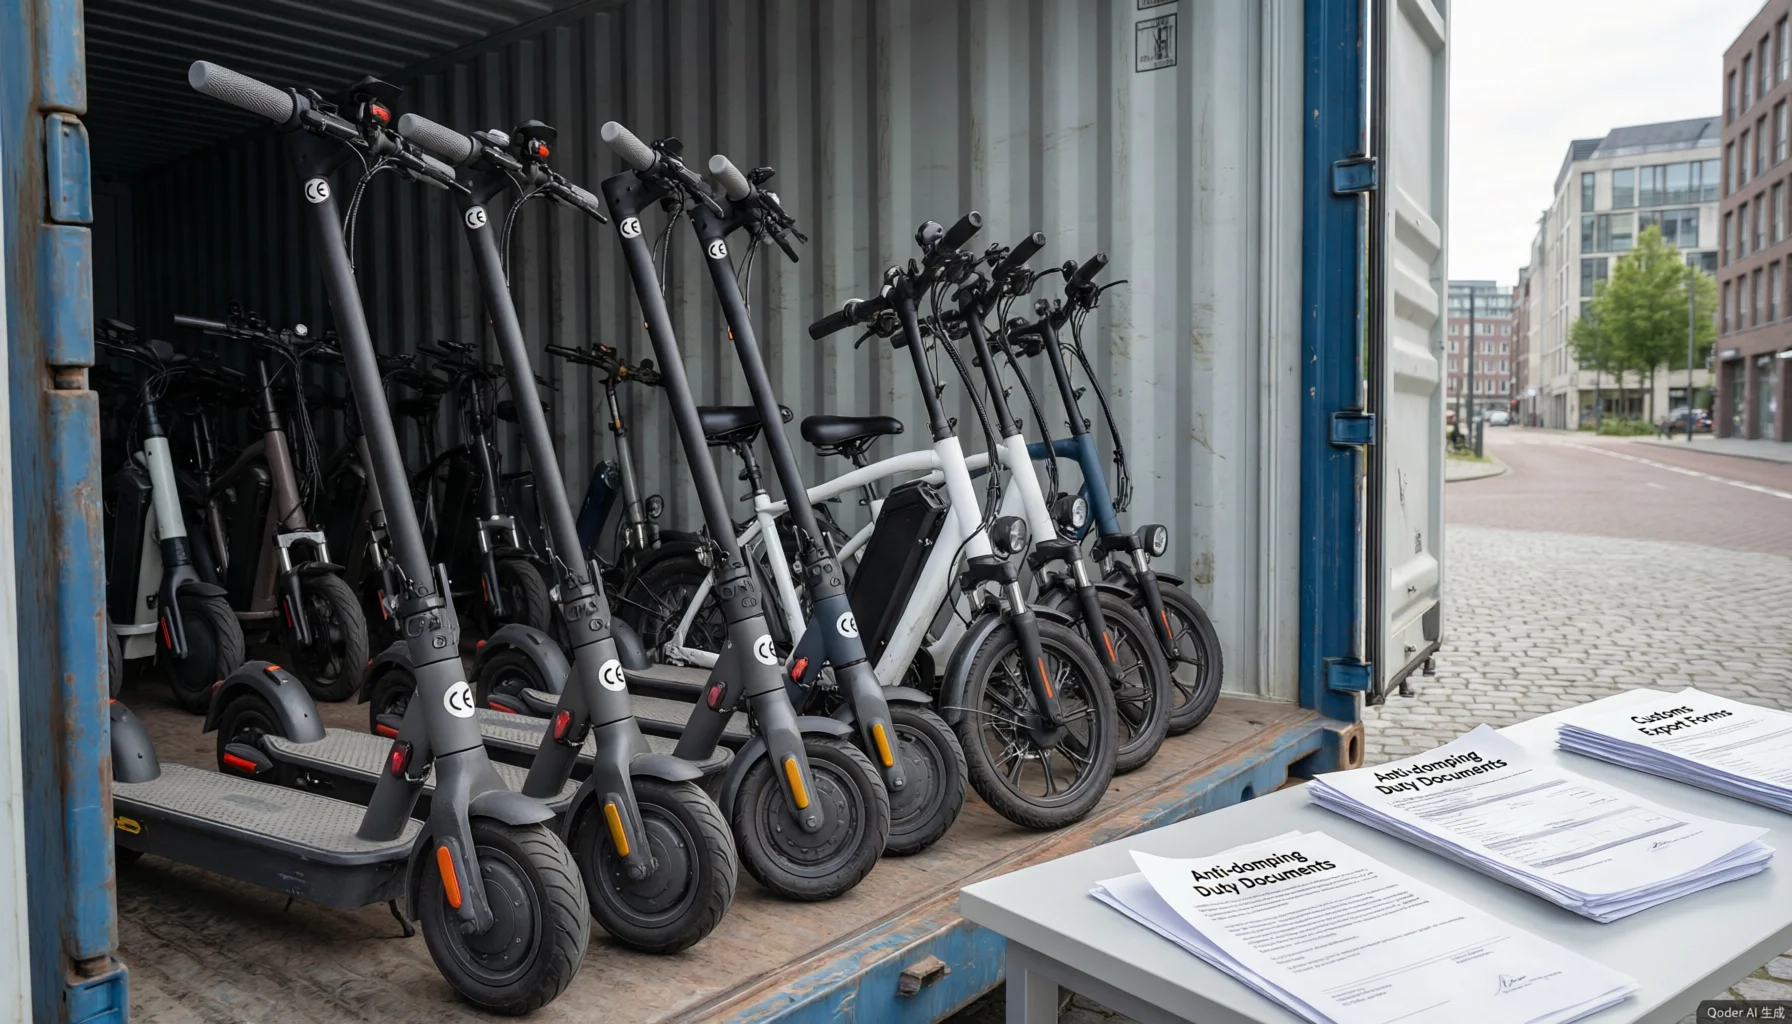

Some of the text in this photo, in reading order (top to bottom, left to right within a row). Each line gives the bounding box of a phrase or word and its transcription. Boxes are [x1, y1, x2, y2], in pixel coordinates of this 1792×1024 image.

[306, 181, 327, 200] CE
[467, 210, 485, 226] CE
[621, 220, 640, 235] CE
[710, 243, 726, 257] CE
[841, 617, 858, 633] CE
[604, 665, 625, 685] CE
[449, 687, 473, 711] CE
[1630, 705, 1694, 725] Customs
[1684, 709, 1734, 726] Forms
[1375, 781, 1420, 795] Duty
[1416, 759, 1508, 786] Documents
[1191, 851, 1309, 883] Anti-domping
[1193, 882, 1241, 897] Duty
[1238, 860, 1337, 889] Documents
